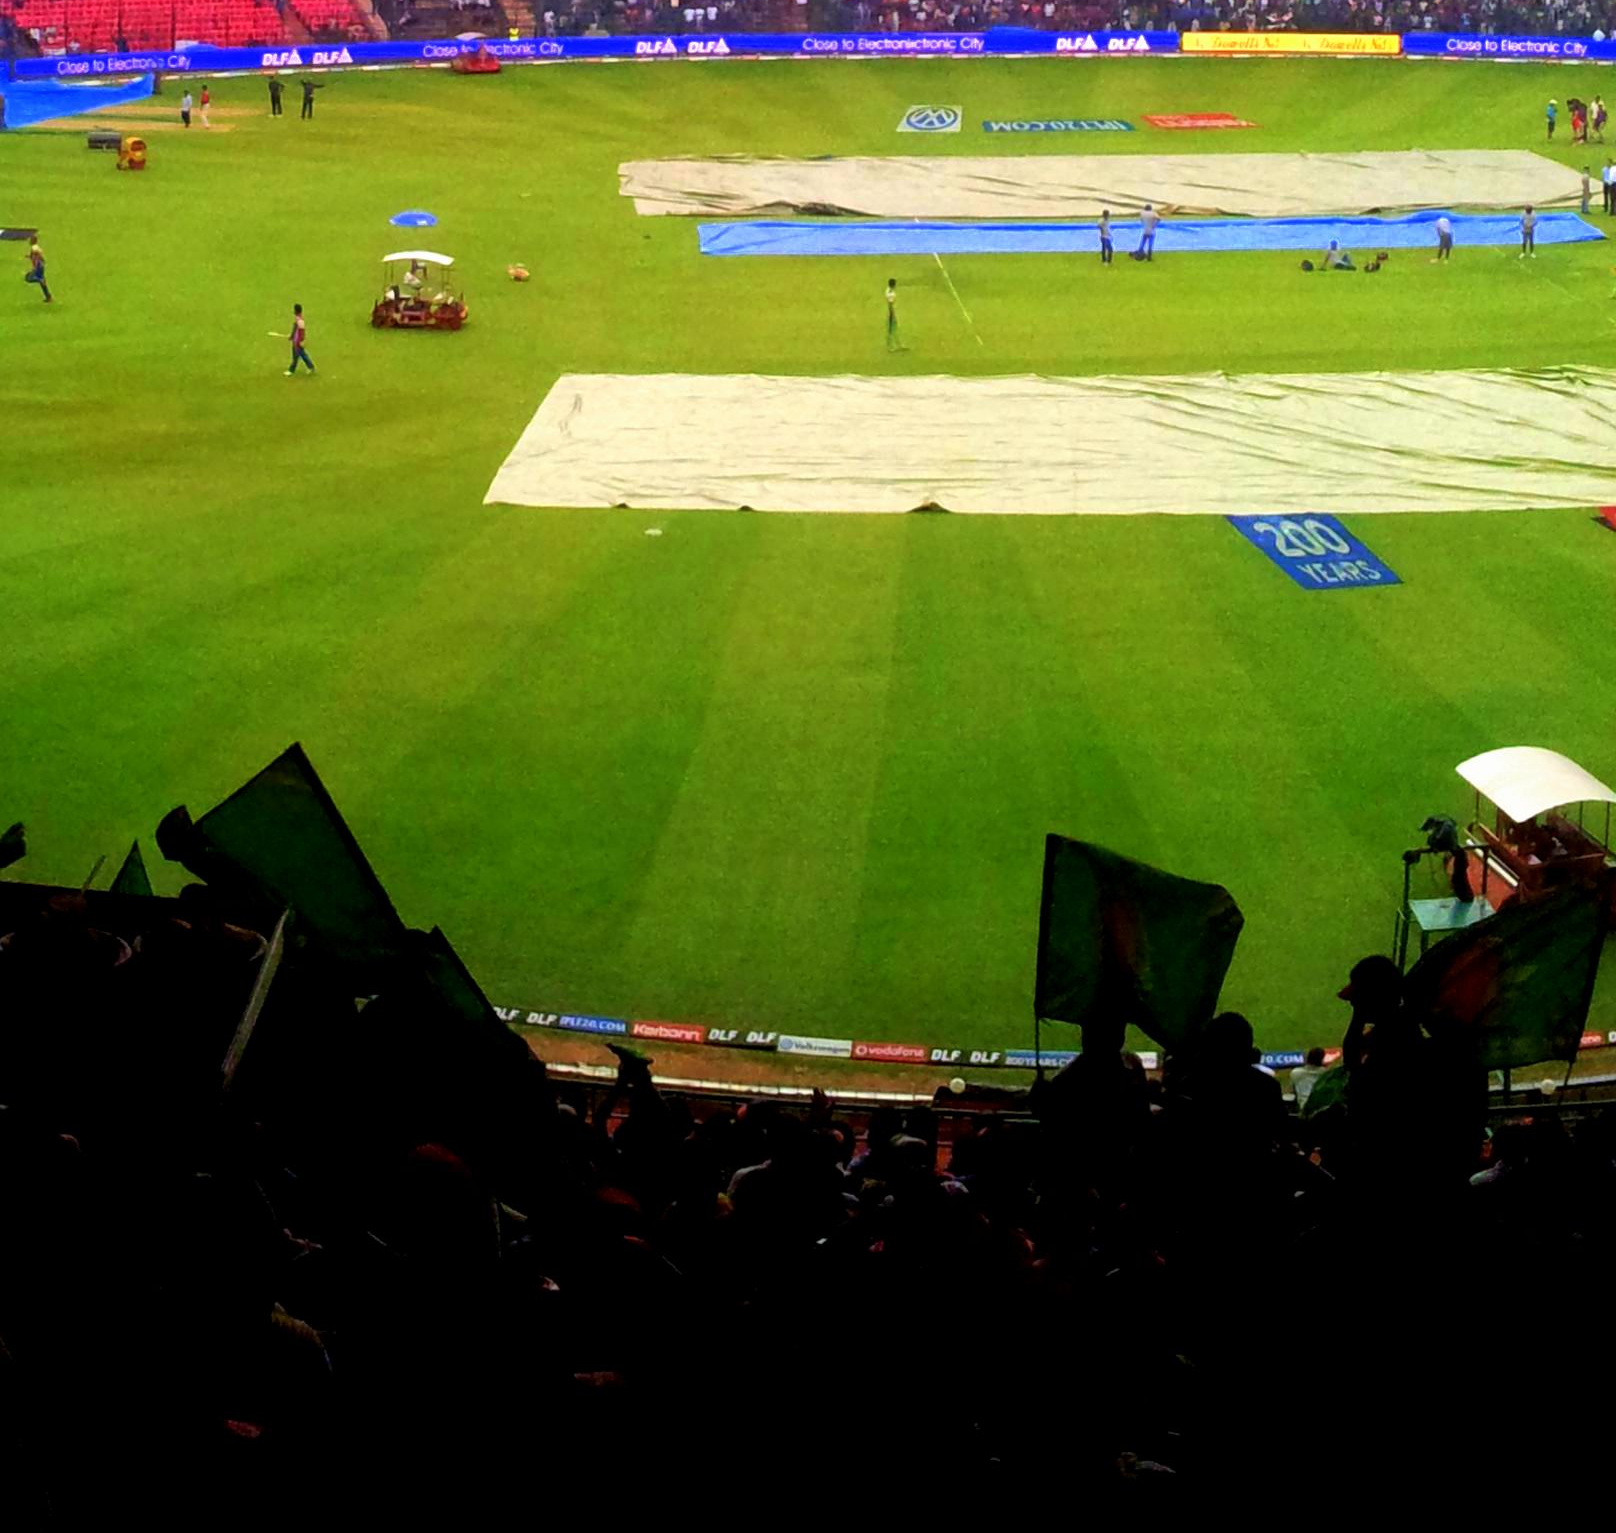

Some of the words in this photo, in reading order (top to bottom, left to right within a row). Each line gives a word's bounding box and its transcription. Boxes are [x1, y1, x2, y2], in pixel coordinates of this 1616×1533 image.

[424, 45, 457, 57] Close
[539, 41, 565, 56] City
[635, 41, 663, 54] DLF
[687, 41, 717, 54] DLF
[802, 37, 838, 51] Close
[842, 38, 855, 50] to
[959, 37, 985, 52] City
[1056, 38, 1084, 51] DLF
[1108, 38, 1137, 51] DLF
[1446, 38, 1481, 51] Close
[1485, 39, 1498, 51] to
[1500, 38, 1559, 54] Electronic
[1562, 39, 1588, 56] City
[262, 53, 291, 66] DLF
[313, 51, 342, 65] DLF
[58, 61, 90, 75] Close
[93, 59, 105, 73] to
[1253, 519, 1350, 557] 200
[1297, 560, 1381, 583] YEARS
[526, 1012, 557, 1025] DLF
[708, 1029, 737, 1041] DLF
[746, 1031, 776, 1043] DLF
[868, 1046, 924, 1058] vodafone
[930, 1049, 961, 1062] DLF
[970, 1051, 1001, 1064] DLF
